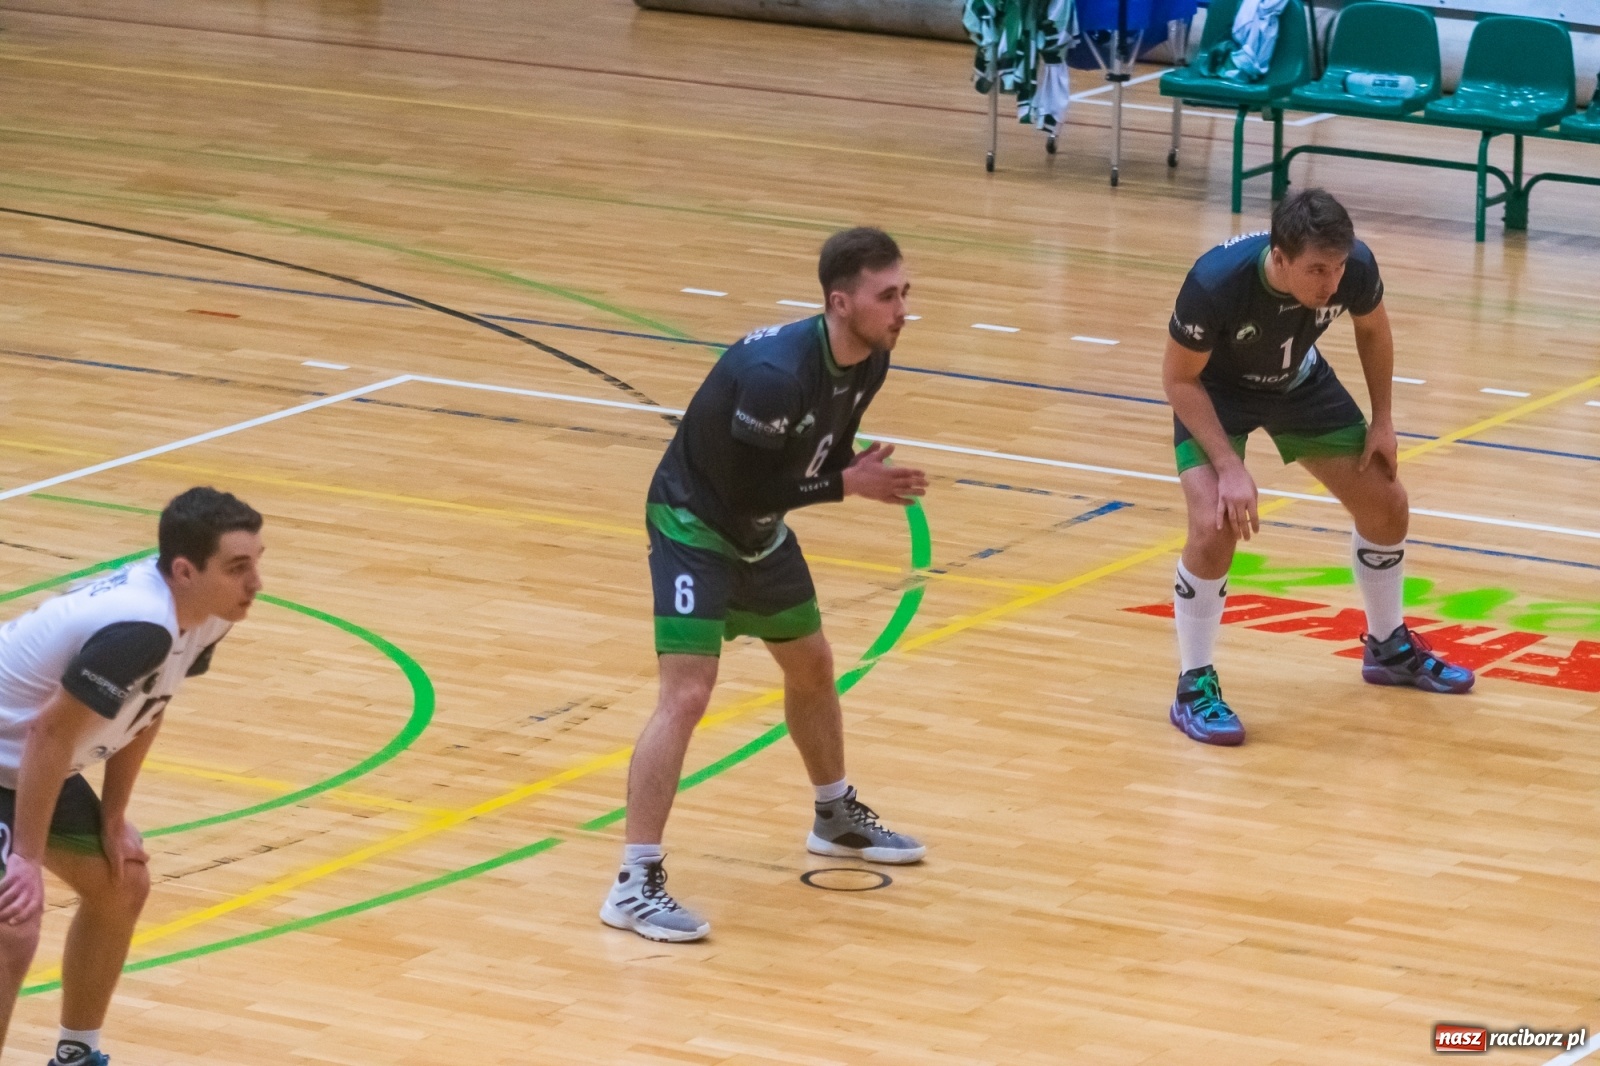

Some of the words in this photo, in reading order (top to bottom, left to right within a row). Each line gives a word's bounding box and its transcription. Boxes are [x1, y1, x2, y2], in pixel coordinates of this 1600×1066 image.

[1280, 337, 1294, 370] 1
[805, 434, 834, 478] 6
[674, 574, 695, 615] 6
[81, 668, 130, 700] POSPIEC
